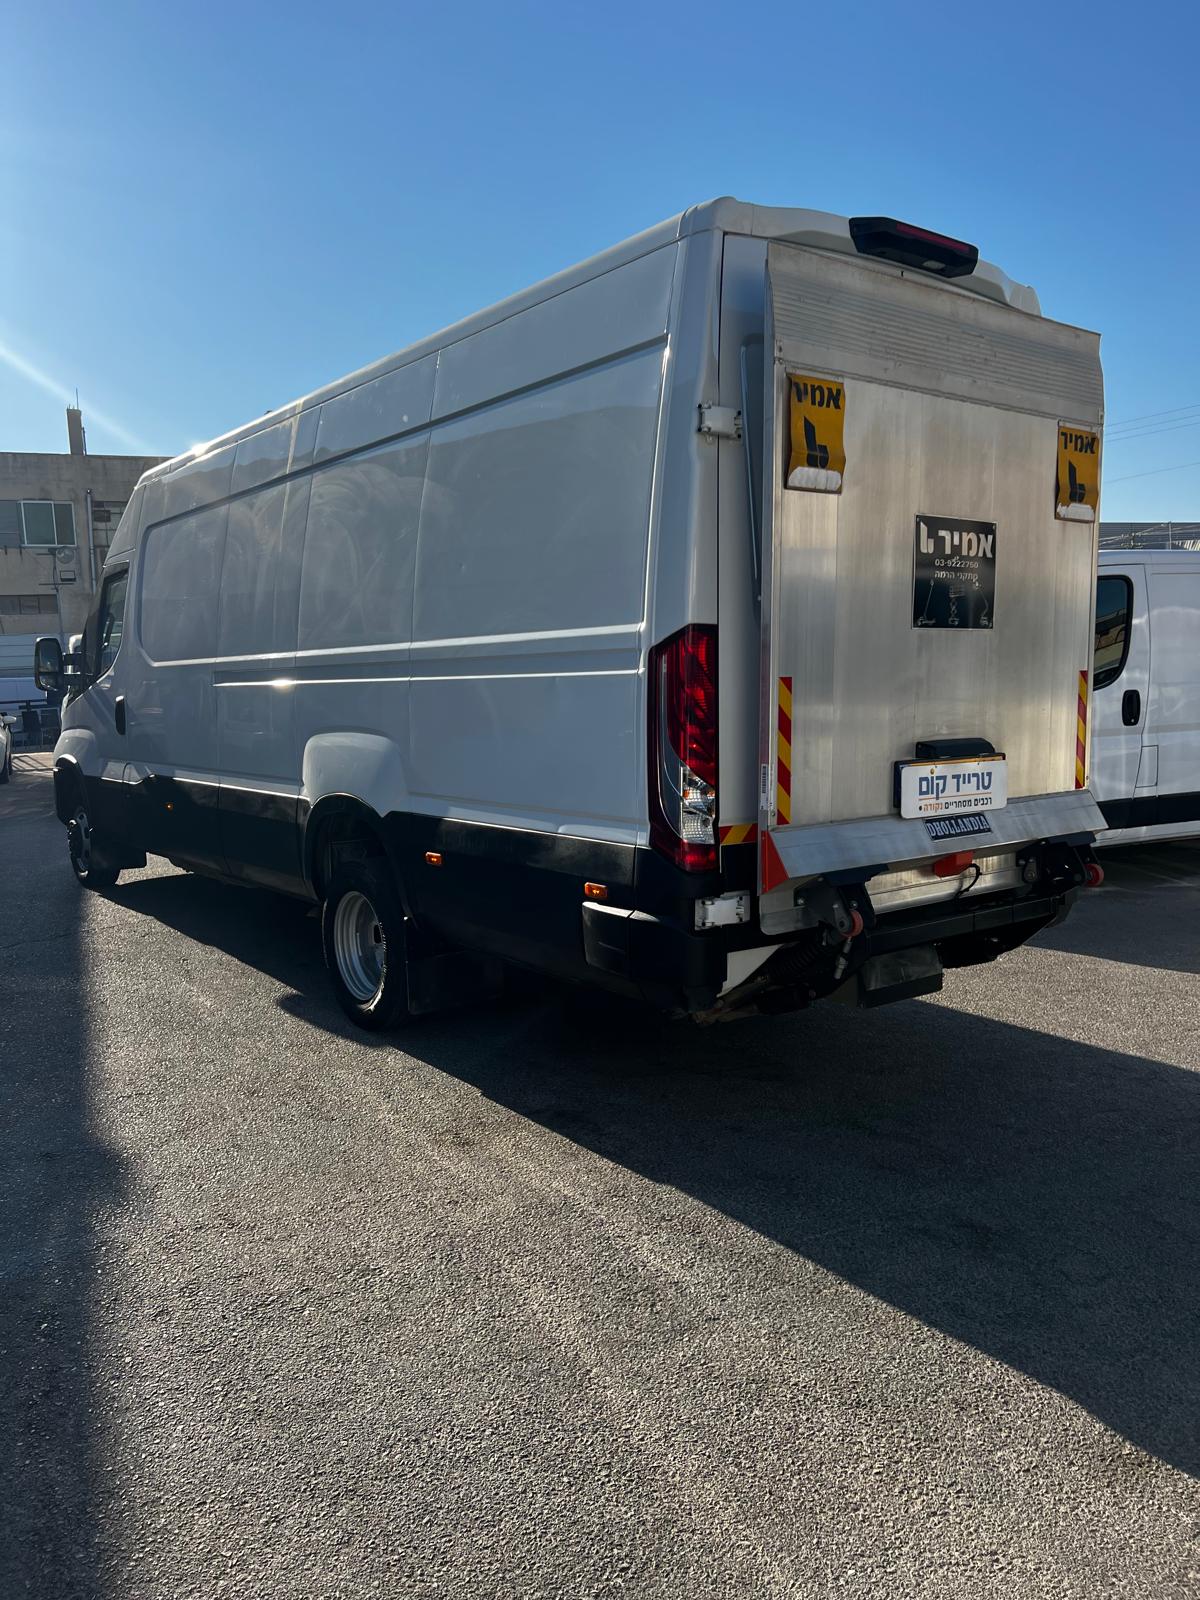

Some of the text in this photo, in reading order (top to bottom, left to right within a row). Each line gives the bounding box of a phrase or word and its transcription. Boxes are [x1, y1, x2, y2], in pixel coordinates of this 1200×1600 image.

[793, 382, 842, 410] אמיר
[1061, 431, 1097, 455] אמיר
[938, 529, 993, 558] אמיר
[934, 571, 955, 579] הרמה
[919, 772, 992, 800] טרייד קום
[923, 797, 992, 813] רכבים מסחריים נקודה
[926, 816, 990, 836] DHOLLANDIA
